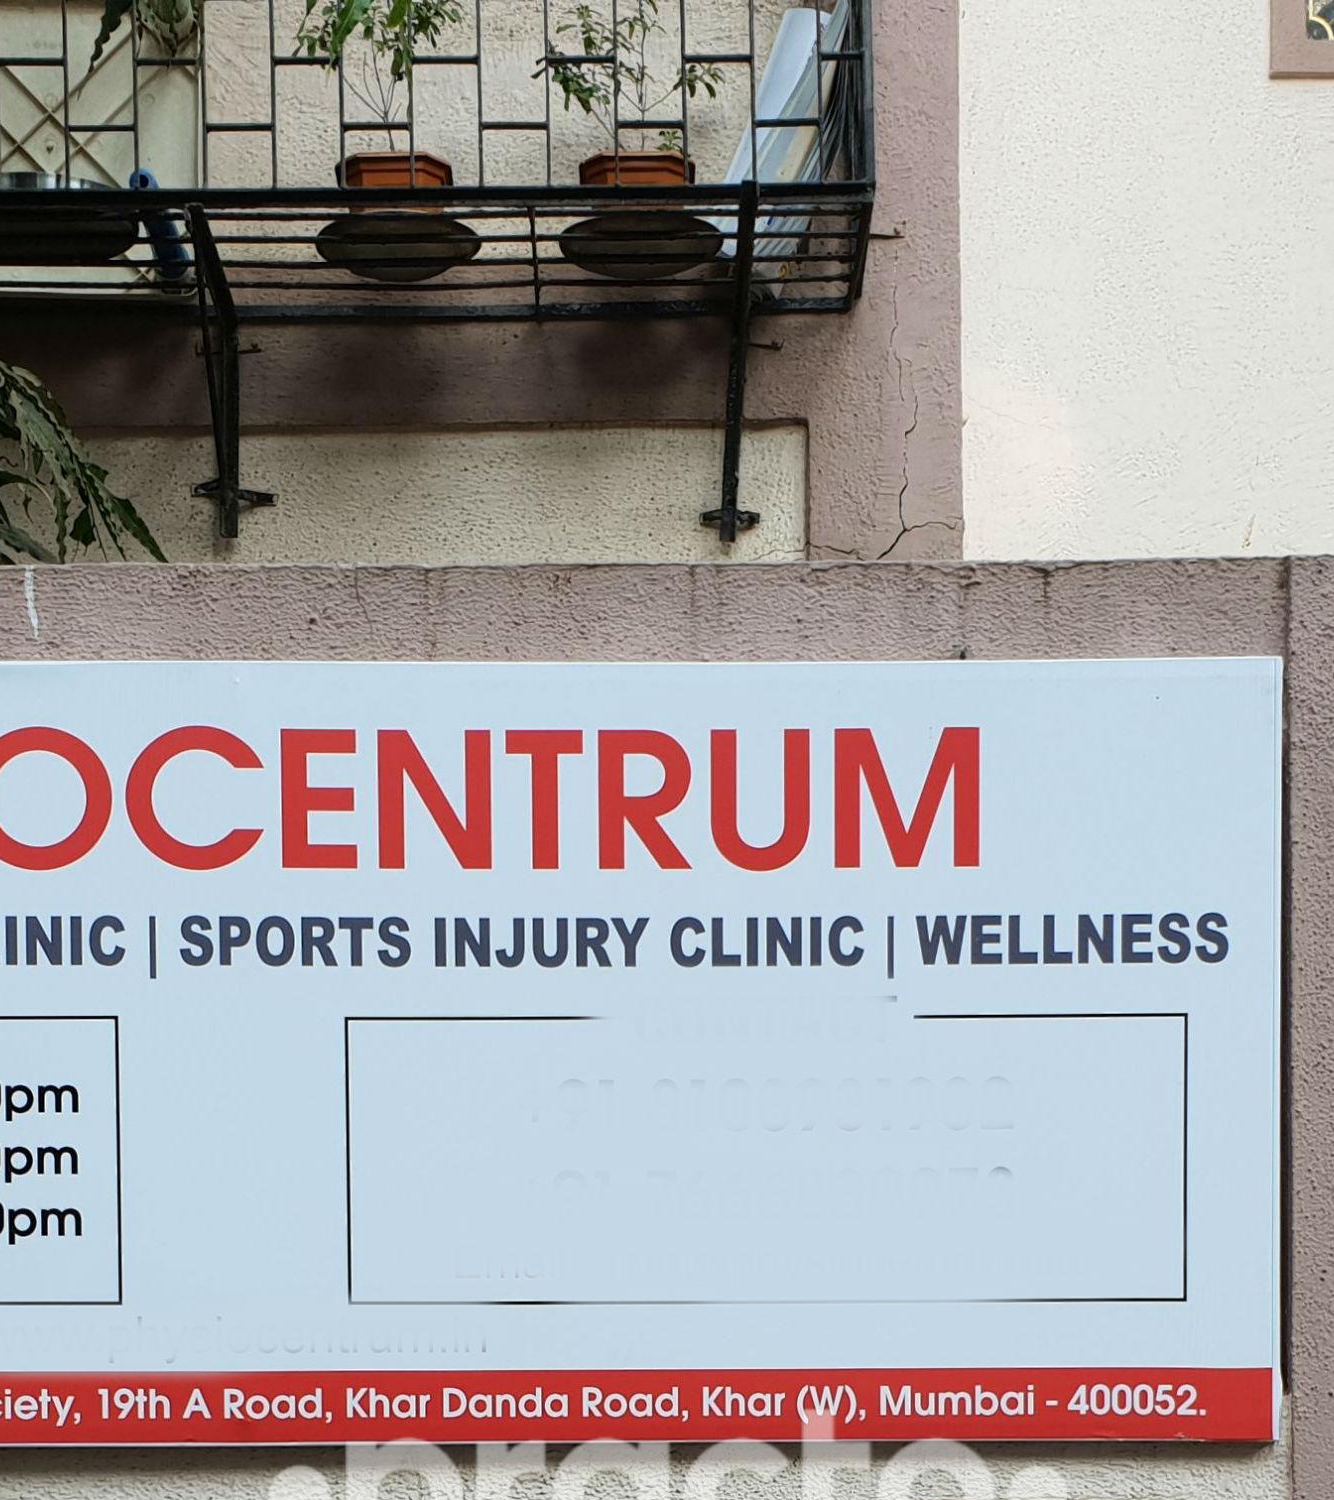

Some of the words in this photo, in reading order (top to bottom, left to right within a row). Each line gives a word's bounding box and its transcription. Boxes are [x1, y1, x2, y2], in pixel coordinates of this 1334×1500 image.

[180, 916, 411, 967] SPORTS
[435, 918, 649, 967] INJURY
[671, 916, 864, 967] CLINIC
[916, 913, 1228, 964] WELLNESS
[98, 1388, 170, 1419] 19th
[183, 1388, 211, 1419] A
[224, 1388, 332, 1423] Road,
[347, 1388, 430, 1418] Khar
[443, 1387, 568, 1418] Danda
[582, 1387, 688, 1421] Road,
[702, 1386, 785, 1417] Khar
[796, 1385, 866, 1423] (W),
[879, 1385, 1034, 1416] Mumbai
[1067, 1383, 1207, 1416] 400052.
